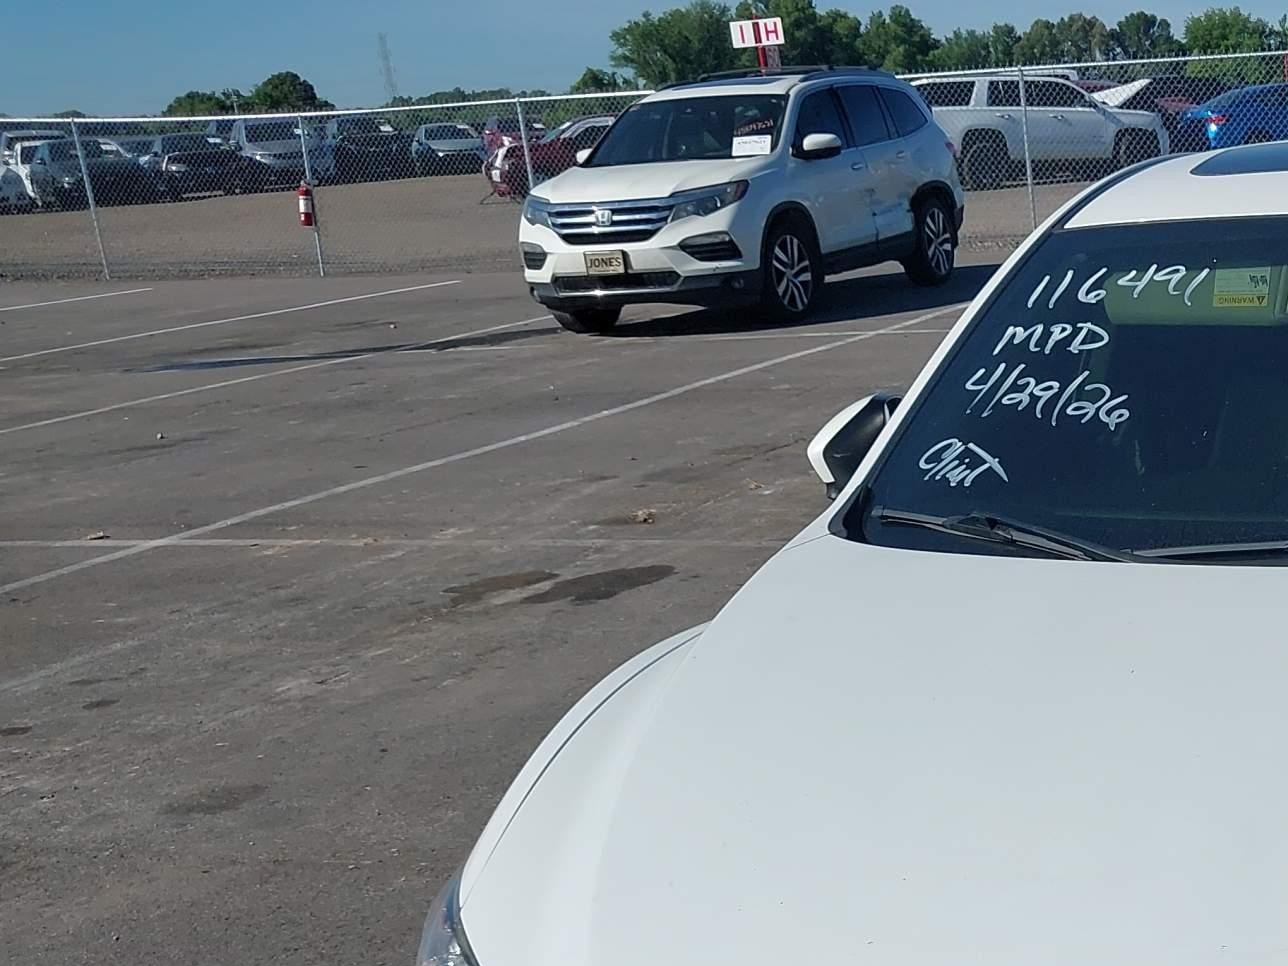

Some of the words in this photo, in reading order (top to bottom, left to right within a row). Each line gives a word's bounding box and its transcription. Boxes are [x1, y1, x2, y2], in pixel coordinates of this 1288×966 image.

[764, 21, 779, 41] H
[587, 256, 622, 268] JONES
[1027, 263, 1210, 309] 116491
[1218, 295, 1255, 305] WARNING
[992, 321, 1110, 356] MPD
[965, 362, 1131, 431] 4/29/26
